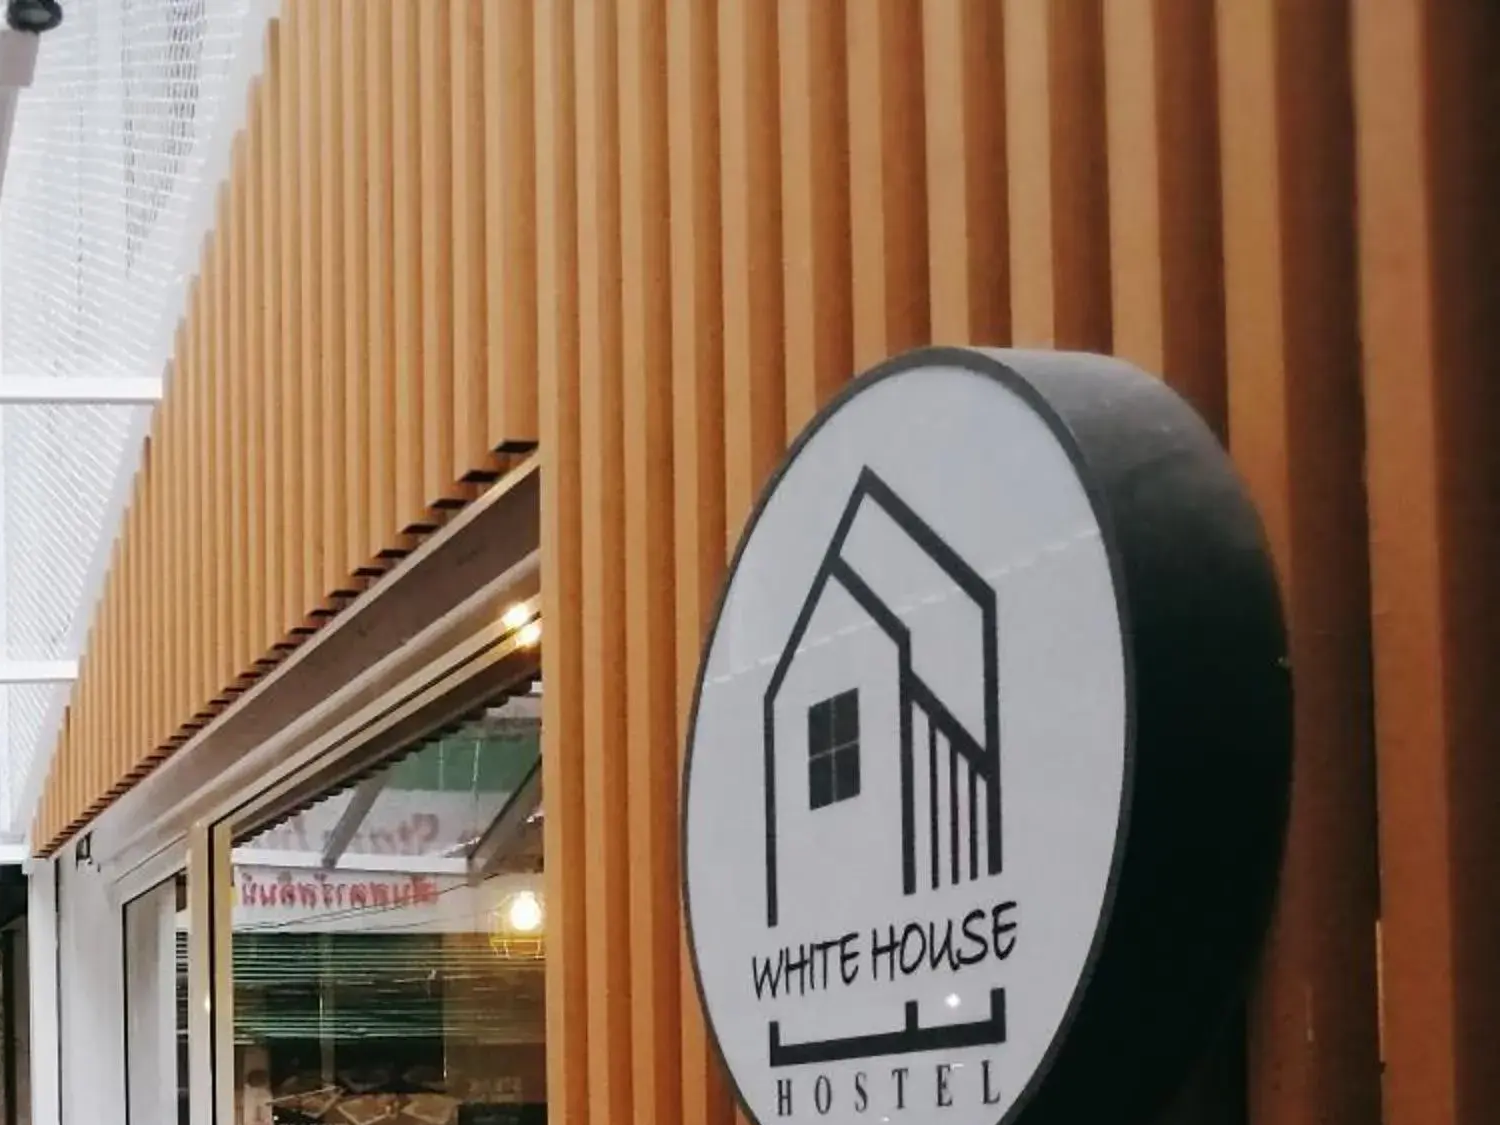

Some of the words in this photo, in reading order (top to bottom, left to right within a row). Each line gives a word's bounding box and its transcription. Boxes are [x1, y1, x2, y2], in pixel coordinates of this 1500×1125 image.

[752, 932, 860, 1001] WHITE
[871, 900, 1018, 981] HOUSE
[776, 1059, 1001, 1117] HOSTEL
